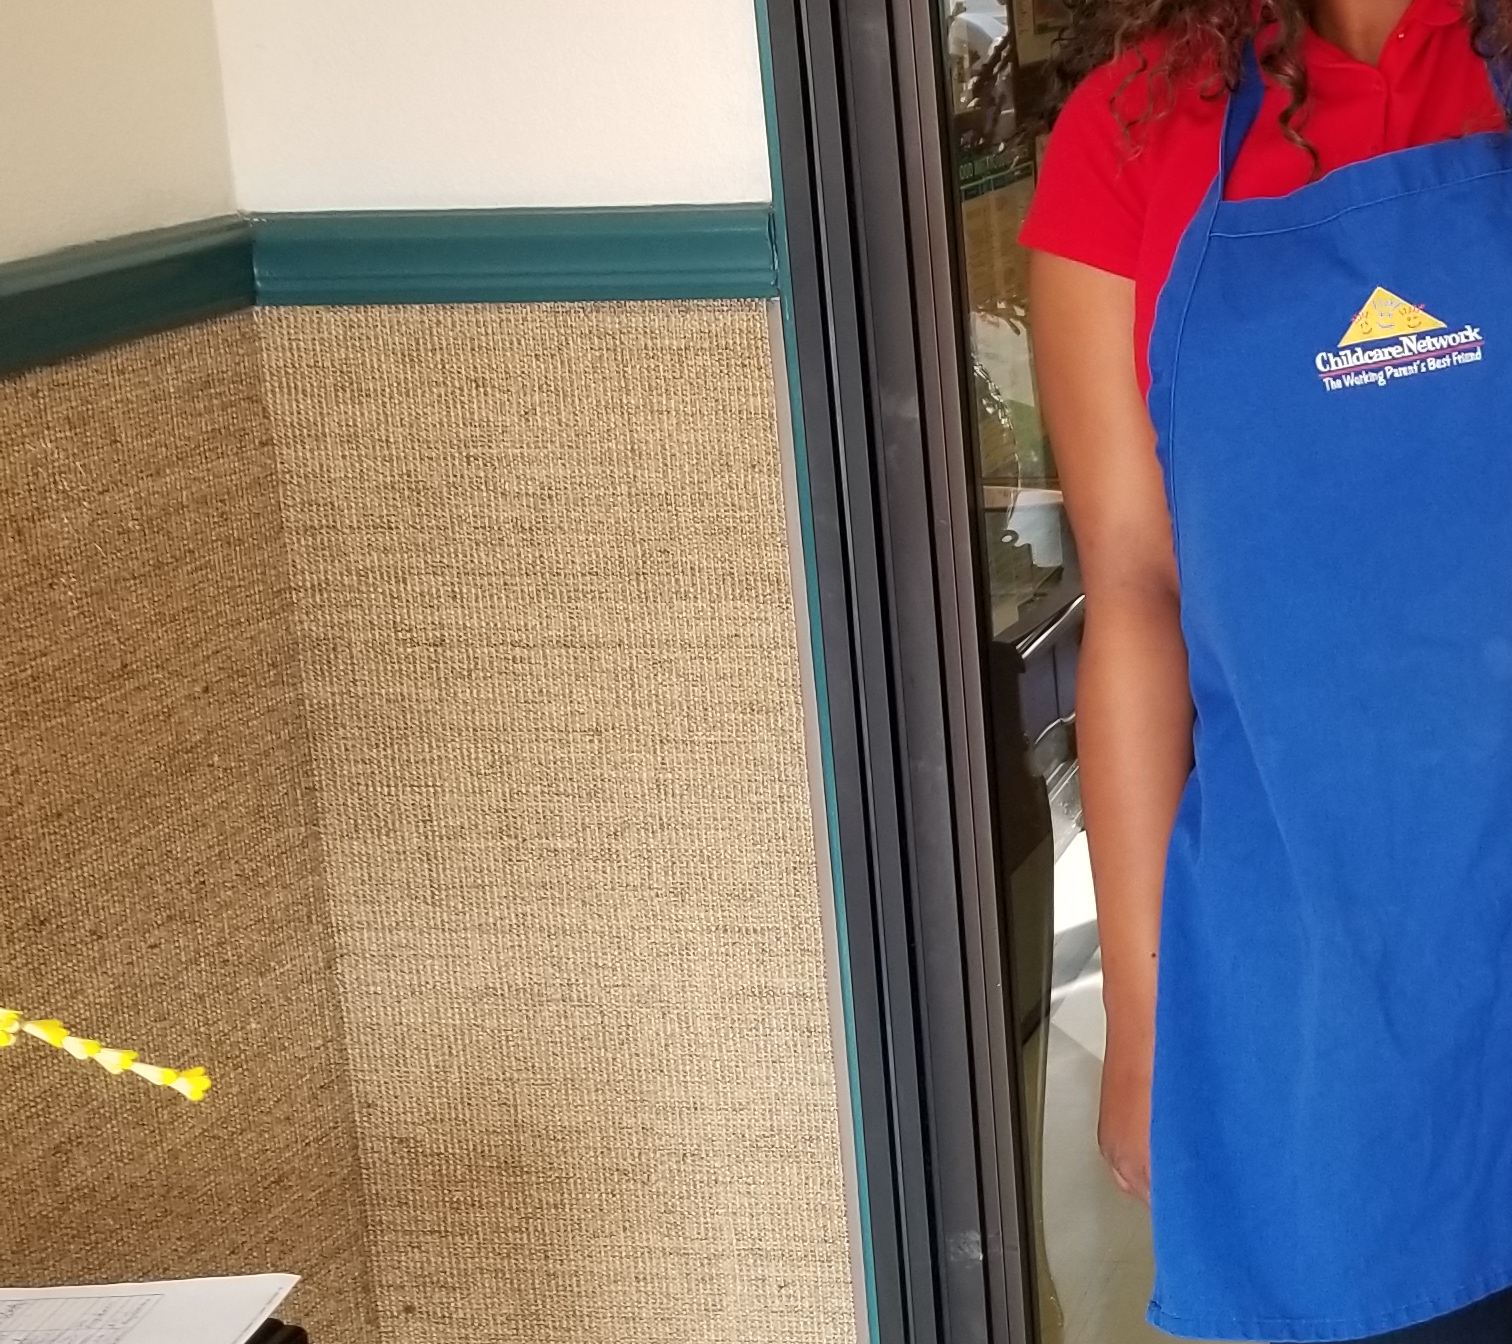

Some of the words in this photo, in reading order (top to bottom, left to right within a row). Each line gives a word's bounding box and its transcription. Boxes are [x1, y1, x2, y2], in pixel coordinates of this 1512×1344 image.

[1323, 375, 1343, 392] The
[1344, 369, 1386, 386] Working
[1384, 360, 1427, 379] Parent's
[1428, 355, 1451, 371] Best
[1450, 346, 1483, 366] Friend
